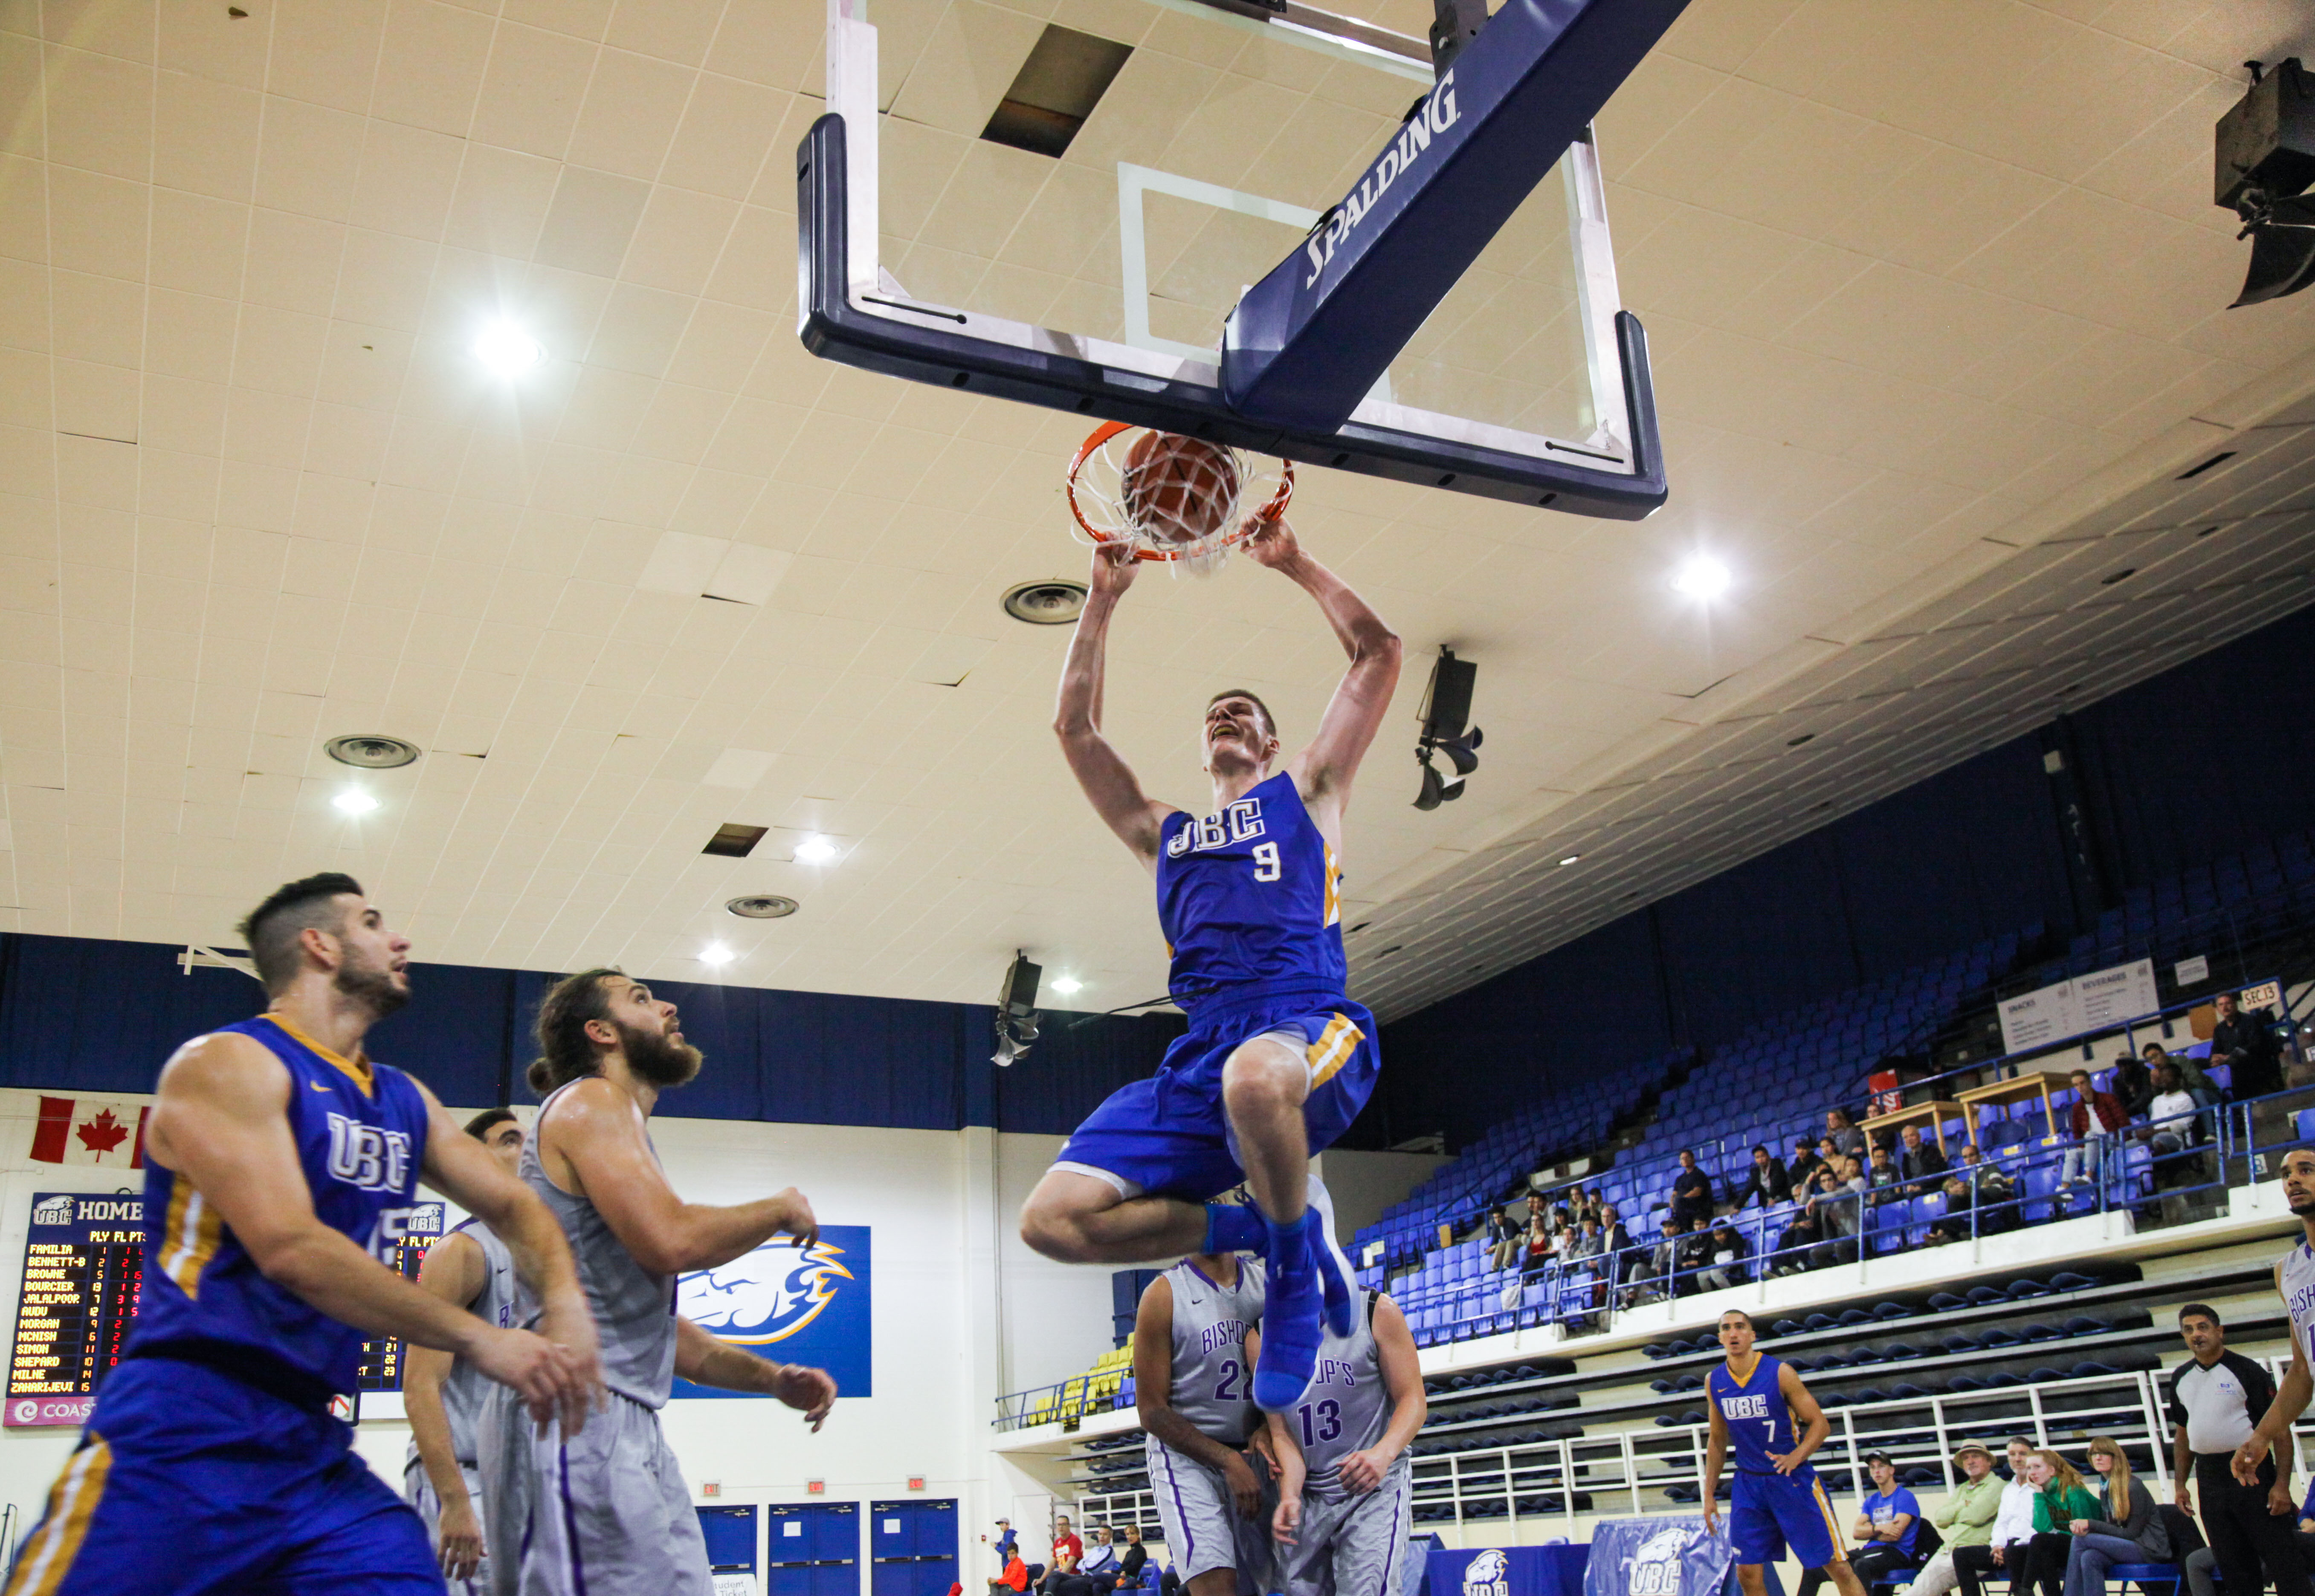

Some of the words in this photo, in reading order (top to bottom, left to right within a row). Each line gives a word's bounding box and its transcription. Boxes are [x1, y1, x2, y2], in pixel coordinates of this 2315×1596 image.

[1252, 841, 1281, 882] 9
[327, 1111, 412, 1194] UBC
[77, 1201, 144, 1220] HOME
[34, 1209, 72, 1225] UBC
[408, 1216, 440, 1232] UBC
[90, 1231, 110, 1242] PLY
[114, 1231, 127, 1242] FL
[410, 1236, 421, 1246] FL
[29, 1244, 72, 1254] FAMILIA
[28, 1257, 85, 1267] BENNETT-B
[99, 1258, 105, 1267] 2
[122, 1258, 129, 1267] 2
[26, 1269, 66, 1279] BROWNE
[97, 1270, 103, 1279] 5
[24, 1281, 74, 1292] BOURCIER
[93, 1282, 102, 1292] 13
[133, 1283, 142, 1292] 2
[94, 1295, 100, 1303] 7
[117, 1295, 125, 1304] 3
[132, 1295, 140, 1303] 9
[21, 1307, 48, 1316] AUDU
[90, 1307, 99, 1316] 12
[119, 1307, 123, 1316] 1
[130, 1307, 139, 1316] 5
[19, 1319, 60, 1329] MORGAN
[91, 1319, 98, 1328] 9
[114, 1320, 122, 1328] 2
[17, 1332, 57, 1342] MCNISH
[89, 1332, 96, 1341] 6
[113, 1332, 121, 1341] 2
[16, 1344, 49, 1354] SIMON
[111, 1344, 119, 1353] 2
[385, 1342, 397, 1352] 21
[14, 1357, 60, 1367] SHEPARD
[84, 1357, 93, 1366] 10
[385, 1354, 396, 1364] 22
[12, 1370, 46, 1379] MILNE
[83, 1370, 92, 1379] 14
[384, 1366, 395, 1376] 23
[11, 1382, 74, 1393] ZAHARIJEVI
[81, 1382, 90, 1392] 15
[43, 1403, 97, 1417] COAS
[1721, 1394, 1769, 1420] UBC
[1297, 1398, 1342, 1449] 13
[1762, 1420, 1775, 1443] 7
[1629, 1559, 1681, 1596] UBC
[714, 1580, 744, 1589] tudent
